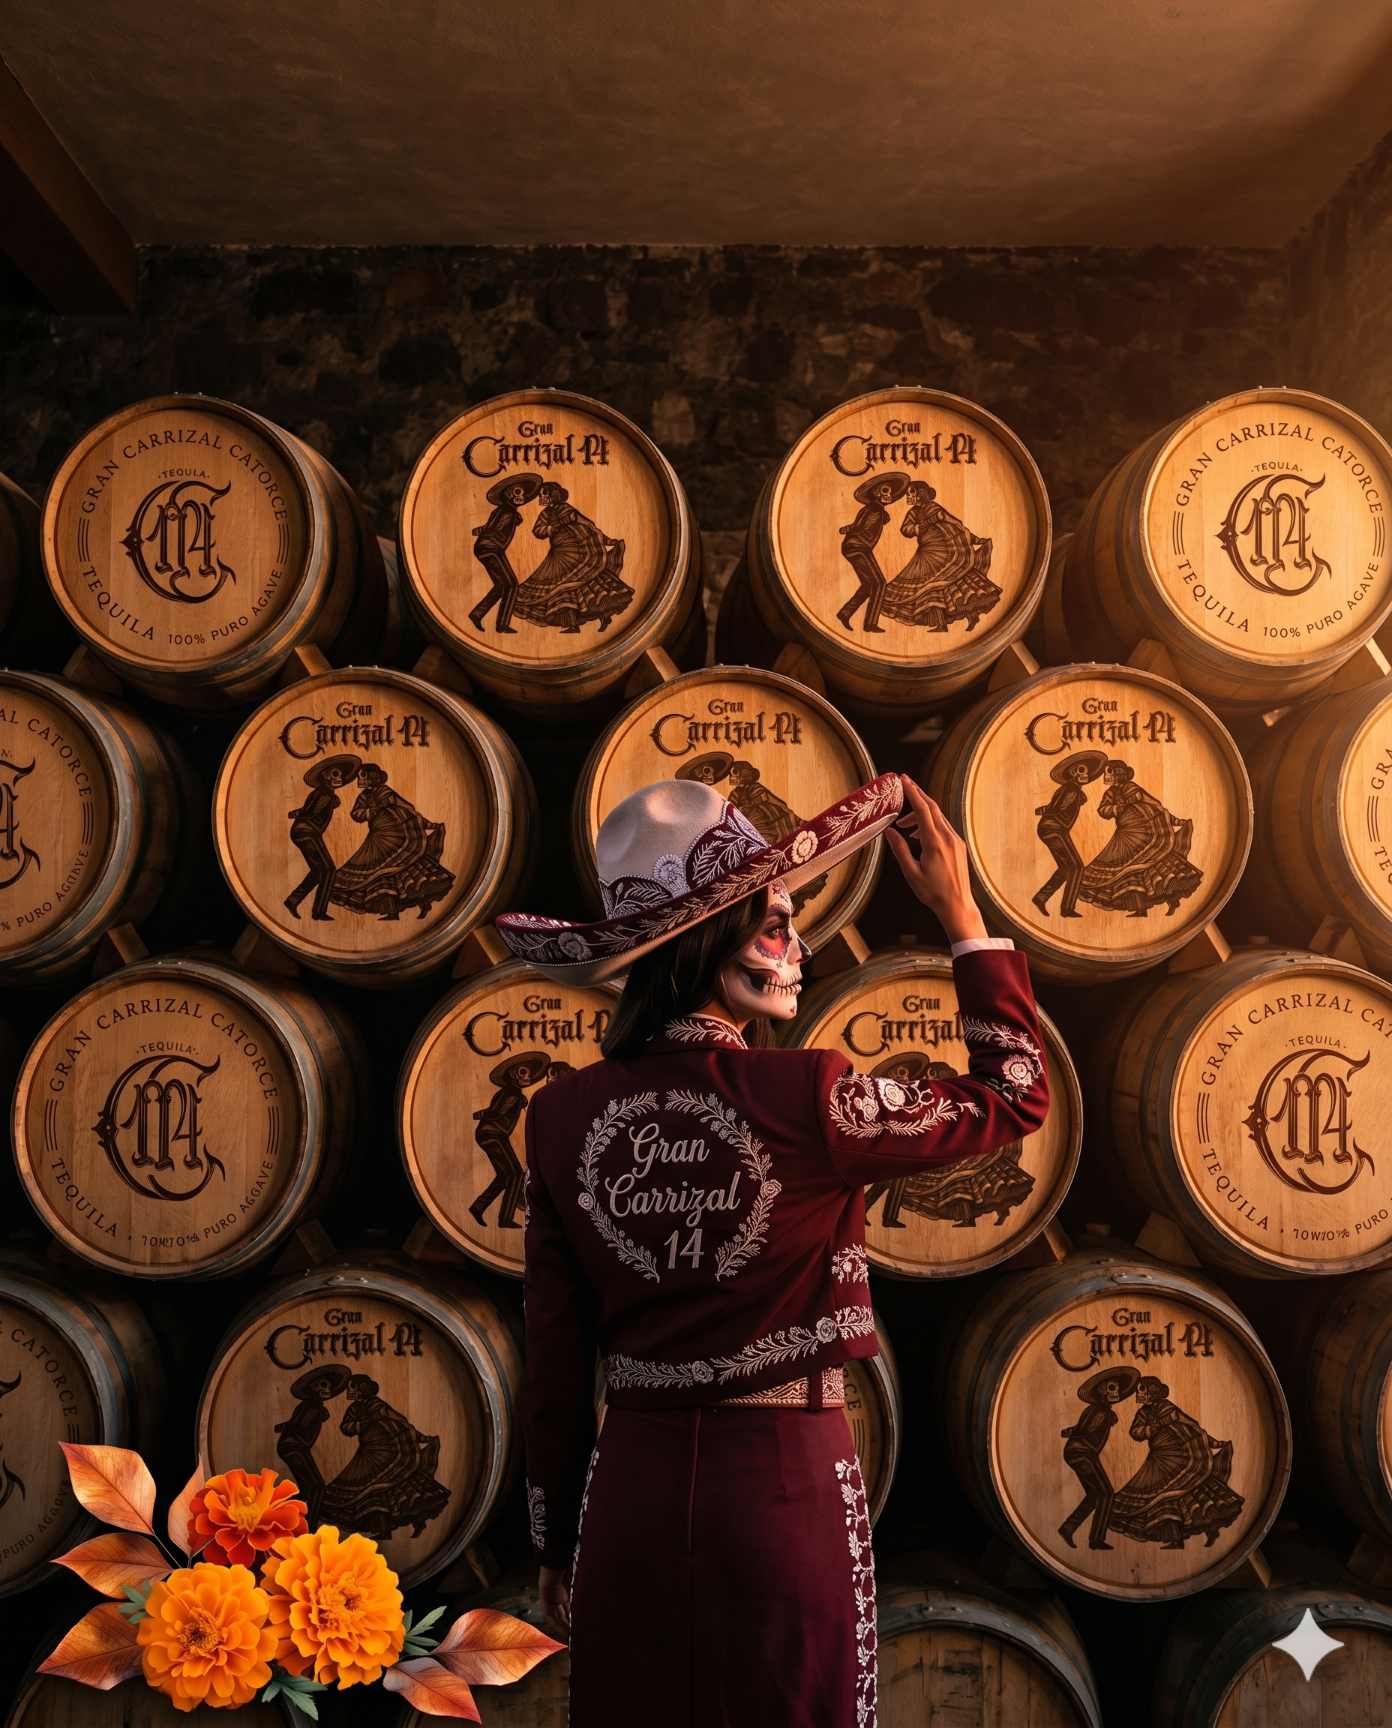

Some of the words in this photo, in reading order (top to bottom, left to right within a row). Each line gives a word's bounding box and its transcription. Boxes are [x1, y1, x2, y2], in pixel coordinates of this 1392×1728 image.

[518, 420, 553, 438] Gran
[885, 419, 921, 437] Gran
[81, 459, 119, 513] GRAN
[122, 429, 223, 459] CARRIZAL
[229, 443, 288, 520] CATORCE
[461, 433, 575, 478] Carrizal
[830, 432, 943, 477] Carrizal
[1176, 452, 1213, 506] GRAN
[1215, 422, 1314, 452] CARRIZAL
[1321, 436, 1383, 514] CATORCE
[82, 567, 155, 640] TEQUILA
[168, 633, 205, 645] 100%
[210, 616, 249, 640] PURO
[251, 569, 283, 616] AGAVE
[1177, 559, 1249, 633] TEQUILA
[1263, 626, 1301, 639] 100%
[1306, 609, 1344, 634] PURO
[1346, 562, 1379, 611] AGAVE
[336, 701, 372, 718] Gran
[708, 698, 744, 715] Gran
[1082, 697, 1118, 714] Gran
[278, 714, 394, 760] Carrizal
[649, 711, 765, 757] Carrizal
[1024, 710, 1140, 755] Carrizal
[27, 718, 92, 797] CATORCE
[16, 902, 52, 928] PURO
[523, 995, 562, 1013] Gran
[902, 995, 941, 1013] Gran
[50, 1030, 93, 1093] GRAN
[96, 998, 203, 1029] CARRIZAL
[211, 1012, 278, 1100] CATORCE
[462, 1009, 585, 1056] Carrizal
[841, 1010, 964, 1057] Carrizal
[1201, 1024, 1244, 1086] GRAN
[1248, 993, 1354, 1025] CARRIZAL
[629, 1123, 710, 1178] Gran
[51, 1158, 118, 1237] TEQUILA
[204, 1212, 238, 1239] PURO
[604, 1171, 741, 1228] Carrizal
[1203, 1149, 1270, 1232] TEQUILA
[1354, 1208, 1389, 1235] PURO
[664, 1228, 705, 1270] 14
[324, 1307, 363, 1326] Gran
[1111, 1307, 1151, 1326] Gran
[264, 1321, 386, 1370] Carrizal
[1049, 1321, 1177, 1372] Carrizal
[11, 1329, 78, 1416] CATORCE
